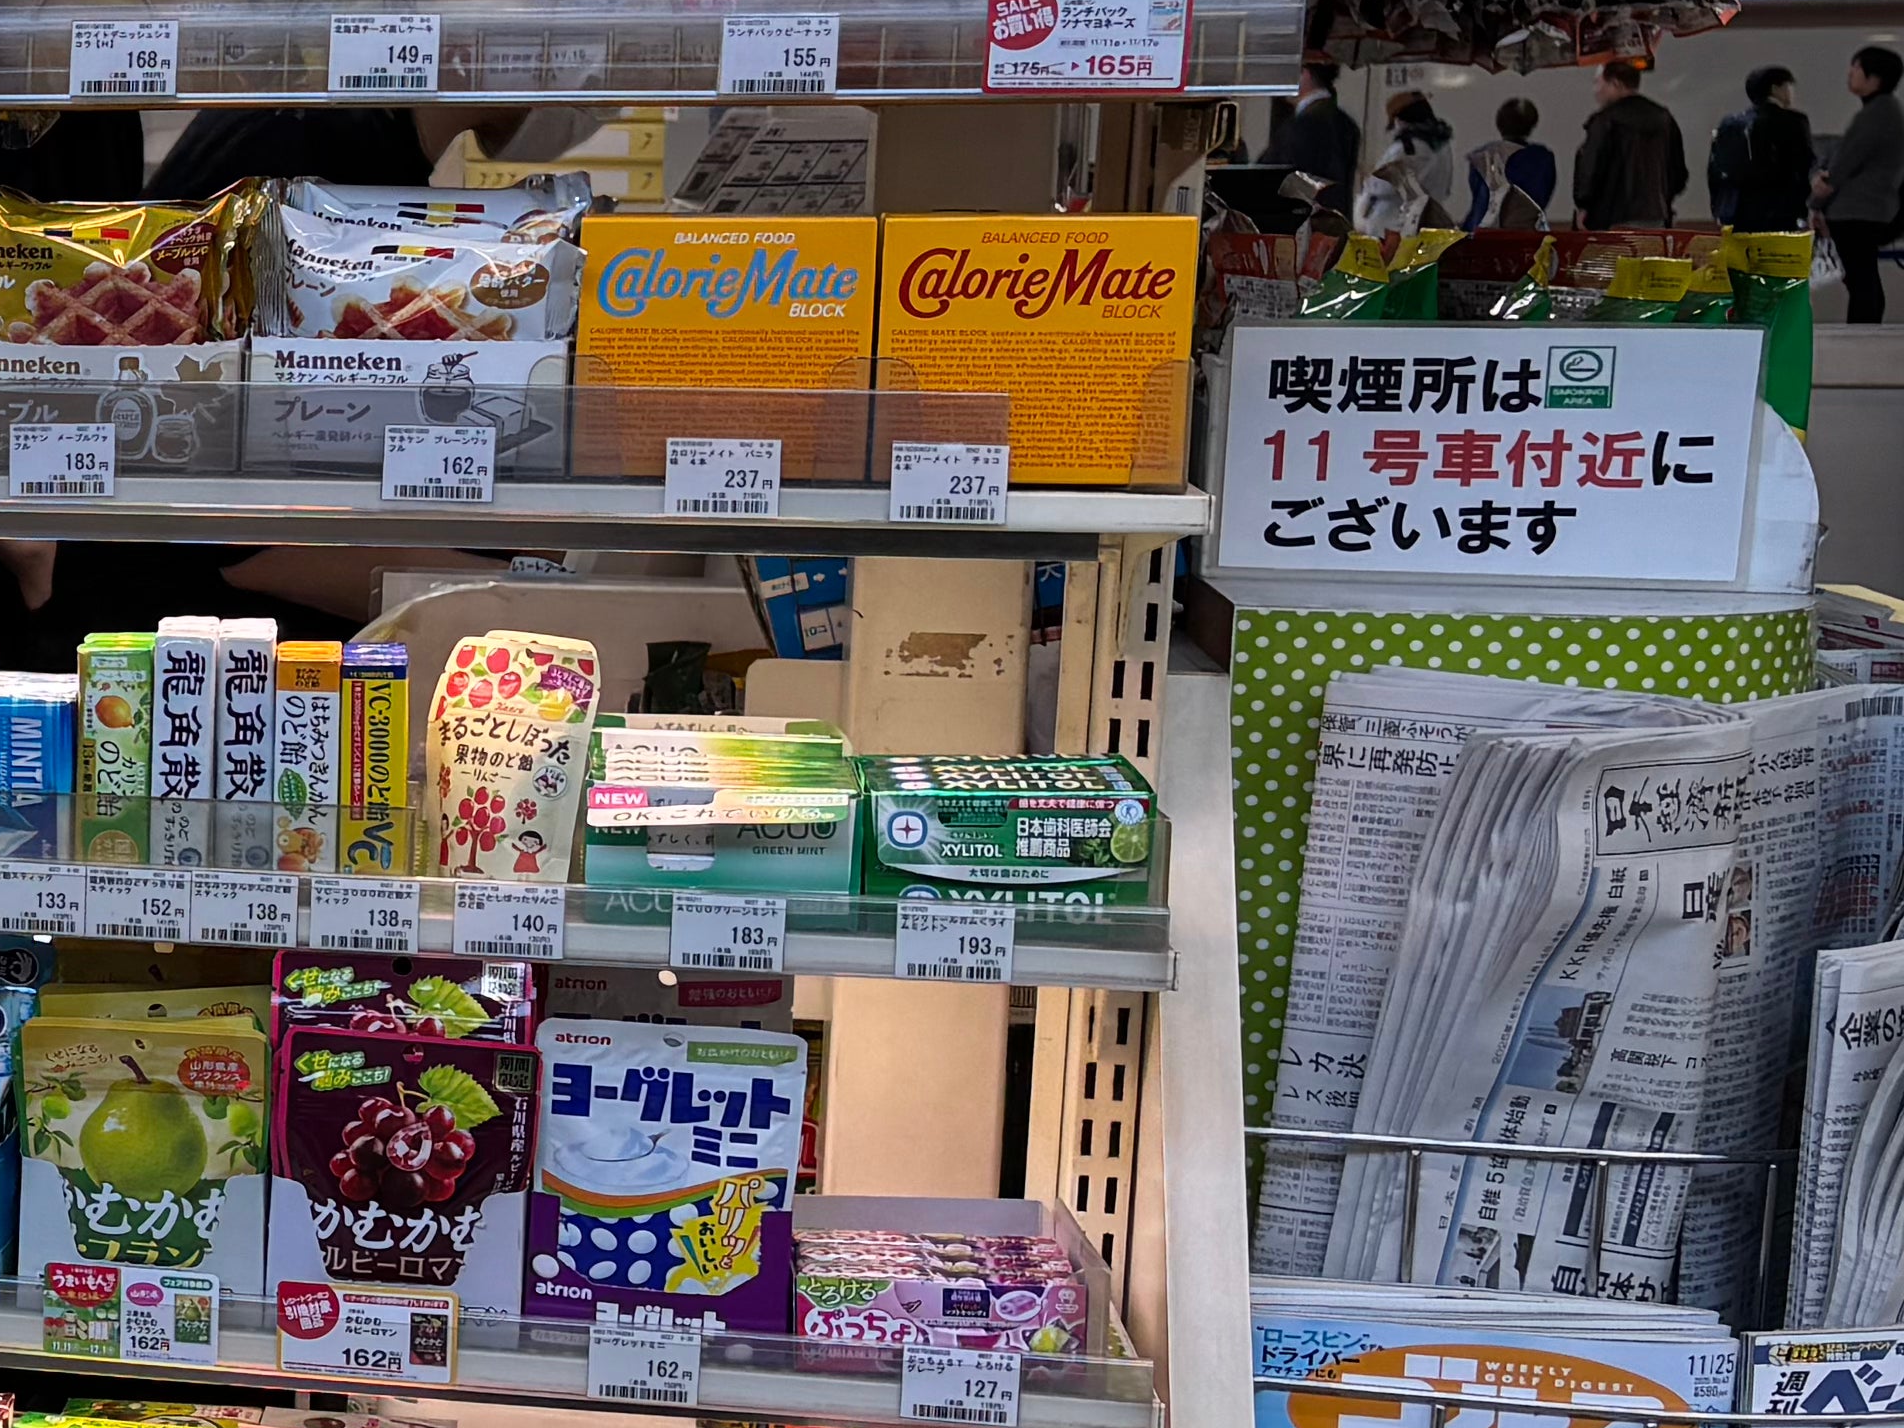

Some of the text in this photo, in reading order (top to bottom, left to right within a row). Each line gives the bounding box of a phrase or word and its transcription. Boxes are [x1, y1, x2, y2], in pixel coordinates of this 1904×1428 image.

[125, 50, 170, 69] 168円
[387, 45, 432, 65] 149円
[783, 47, 831, 69] 155円
[673, 231, 796, 244] BALANCED FOOD
[981, 231, 1109, 244] BALANCED FOOD
[788, 303, 847, 318] BLOCK
[1101, 304, 1163, 319] BLOCK
[275, 350, 402, 372] Manneken
[1268, 354, 1542, 415] 喫煙所は
[1563, 397, 1594, 407] AREA
[440, 455, 488, 476] 162円
[724, 469, 772, 491] 237円
[948, 475, 999, 496] 237円
[1263, 498, 1578, 557] ございます
[160, 648, 207, 799] 龍角散
[438, 715, 573, 766] まるごとしぼった
[454, 747, 535, 773] 果物のど飴
[593, 791, 645, 807] NEW
[1015, 817, 1112, 839] 日本歯科医師会
[1015, 838, 1071, 858] 推薦商品
[141, 897, 185, 918] 152円
[510, 913, 557, 934] 140円
[555, 1031, 611, 1045] atrion
[550, 1061, 792, 1129] ヨーグレット
[692, 1124, 758, 1169] ミニ
[1260, 1344, 1360, 1368] ドライバー
[1485, 1360, 1573, 1377] WEEKLY
[1550, 1377, 1635, 1394] DIGEST
